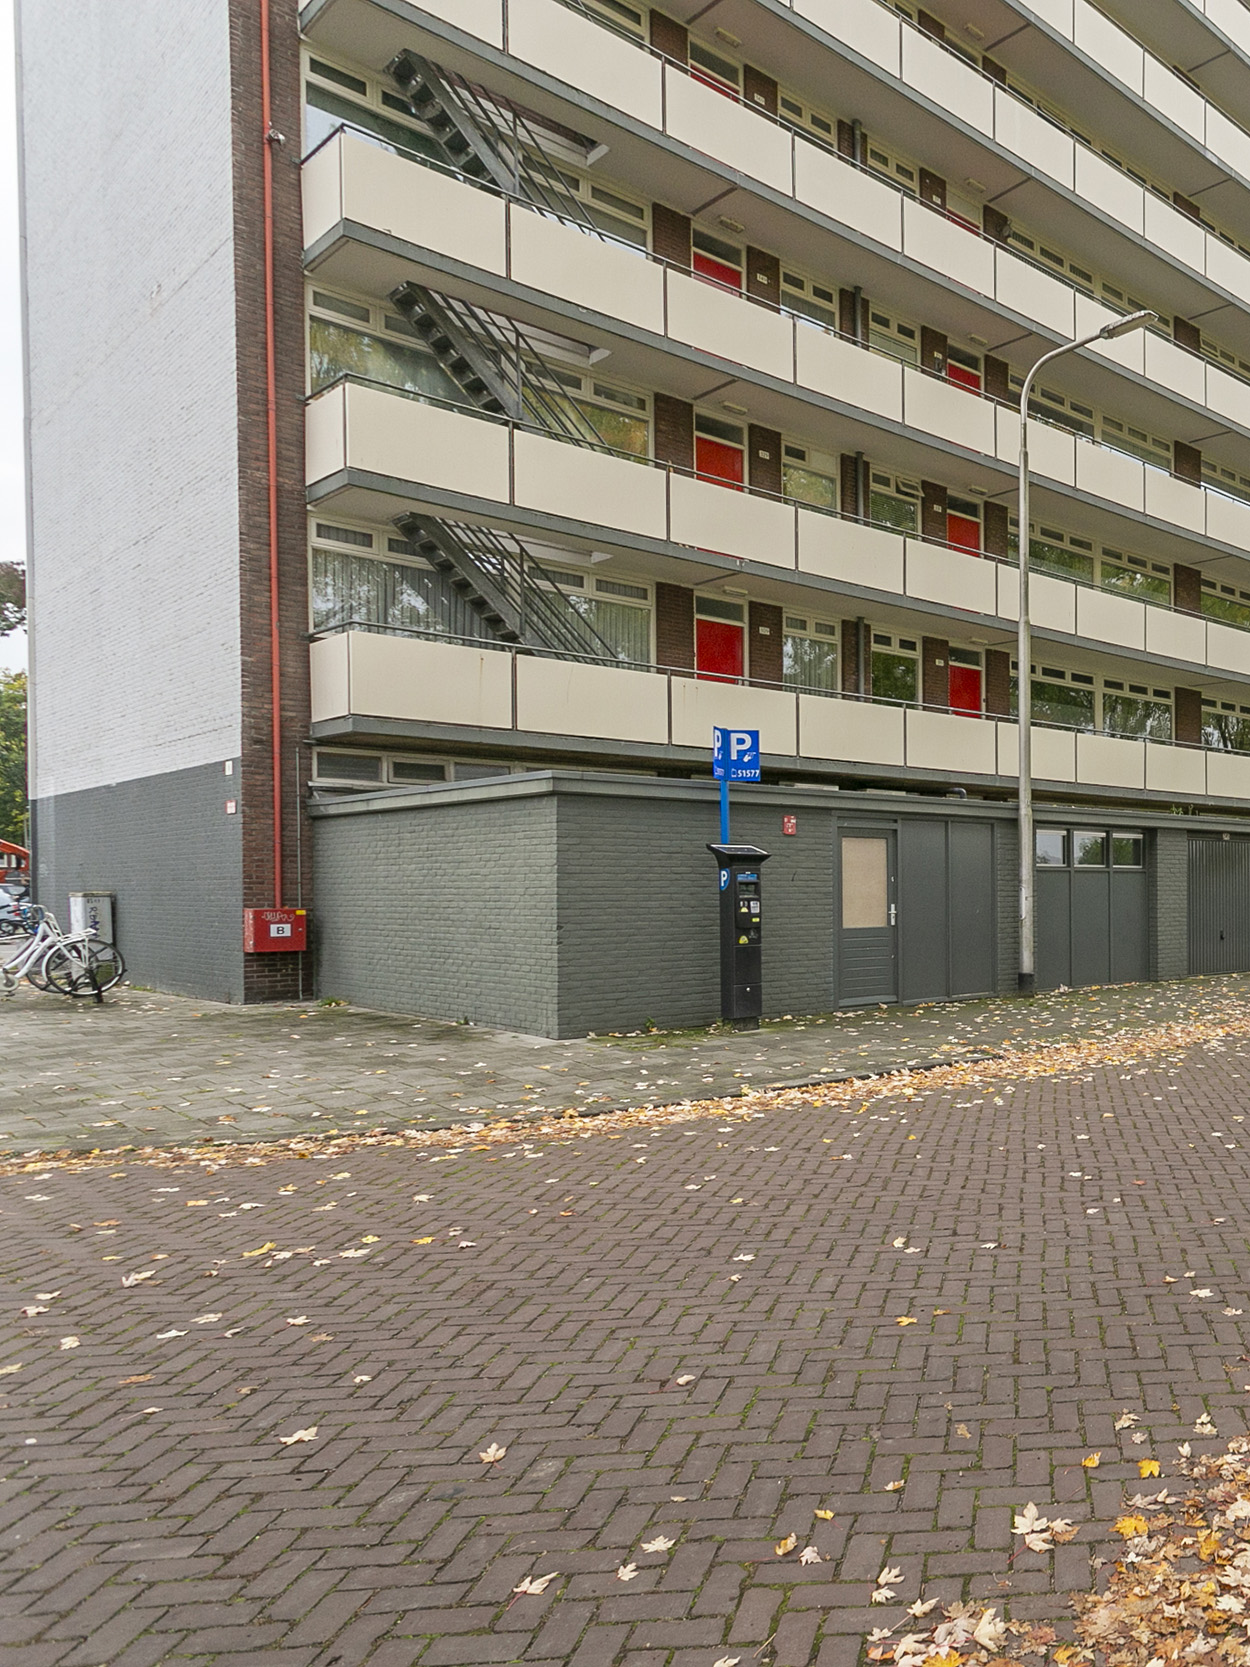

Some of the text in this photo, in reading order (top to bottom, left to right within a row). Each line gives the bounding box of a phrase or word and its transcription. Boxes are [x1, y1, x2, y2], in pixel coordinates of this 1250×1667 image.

[714, 729, 722, 758] P
[730, 732, 752, 760] P
[737, 769, 760, 778] 51577
[720, 870, 728, 887] P
[276, 926, 285, 935] B
